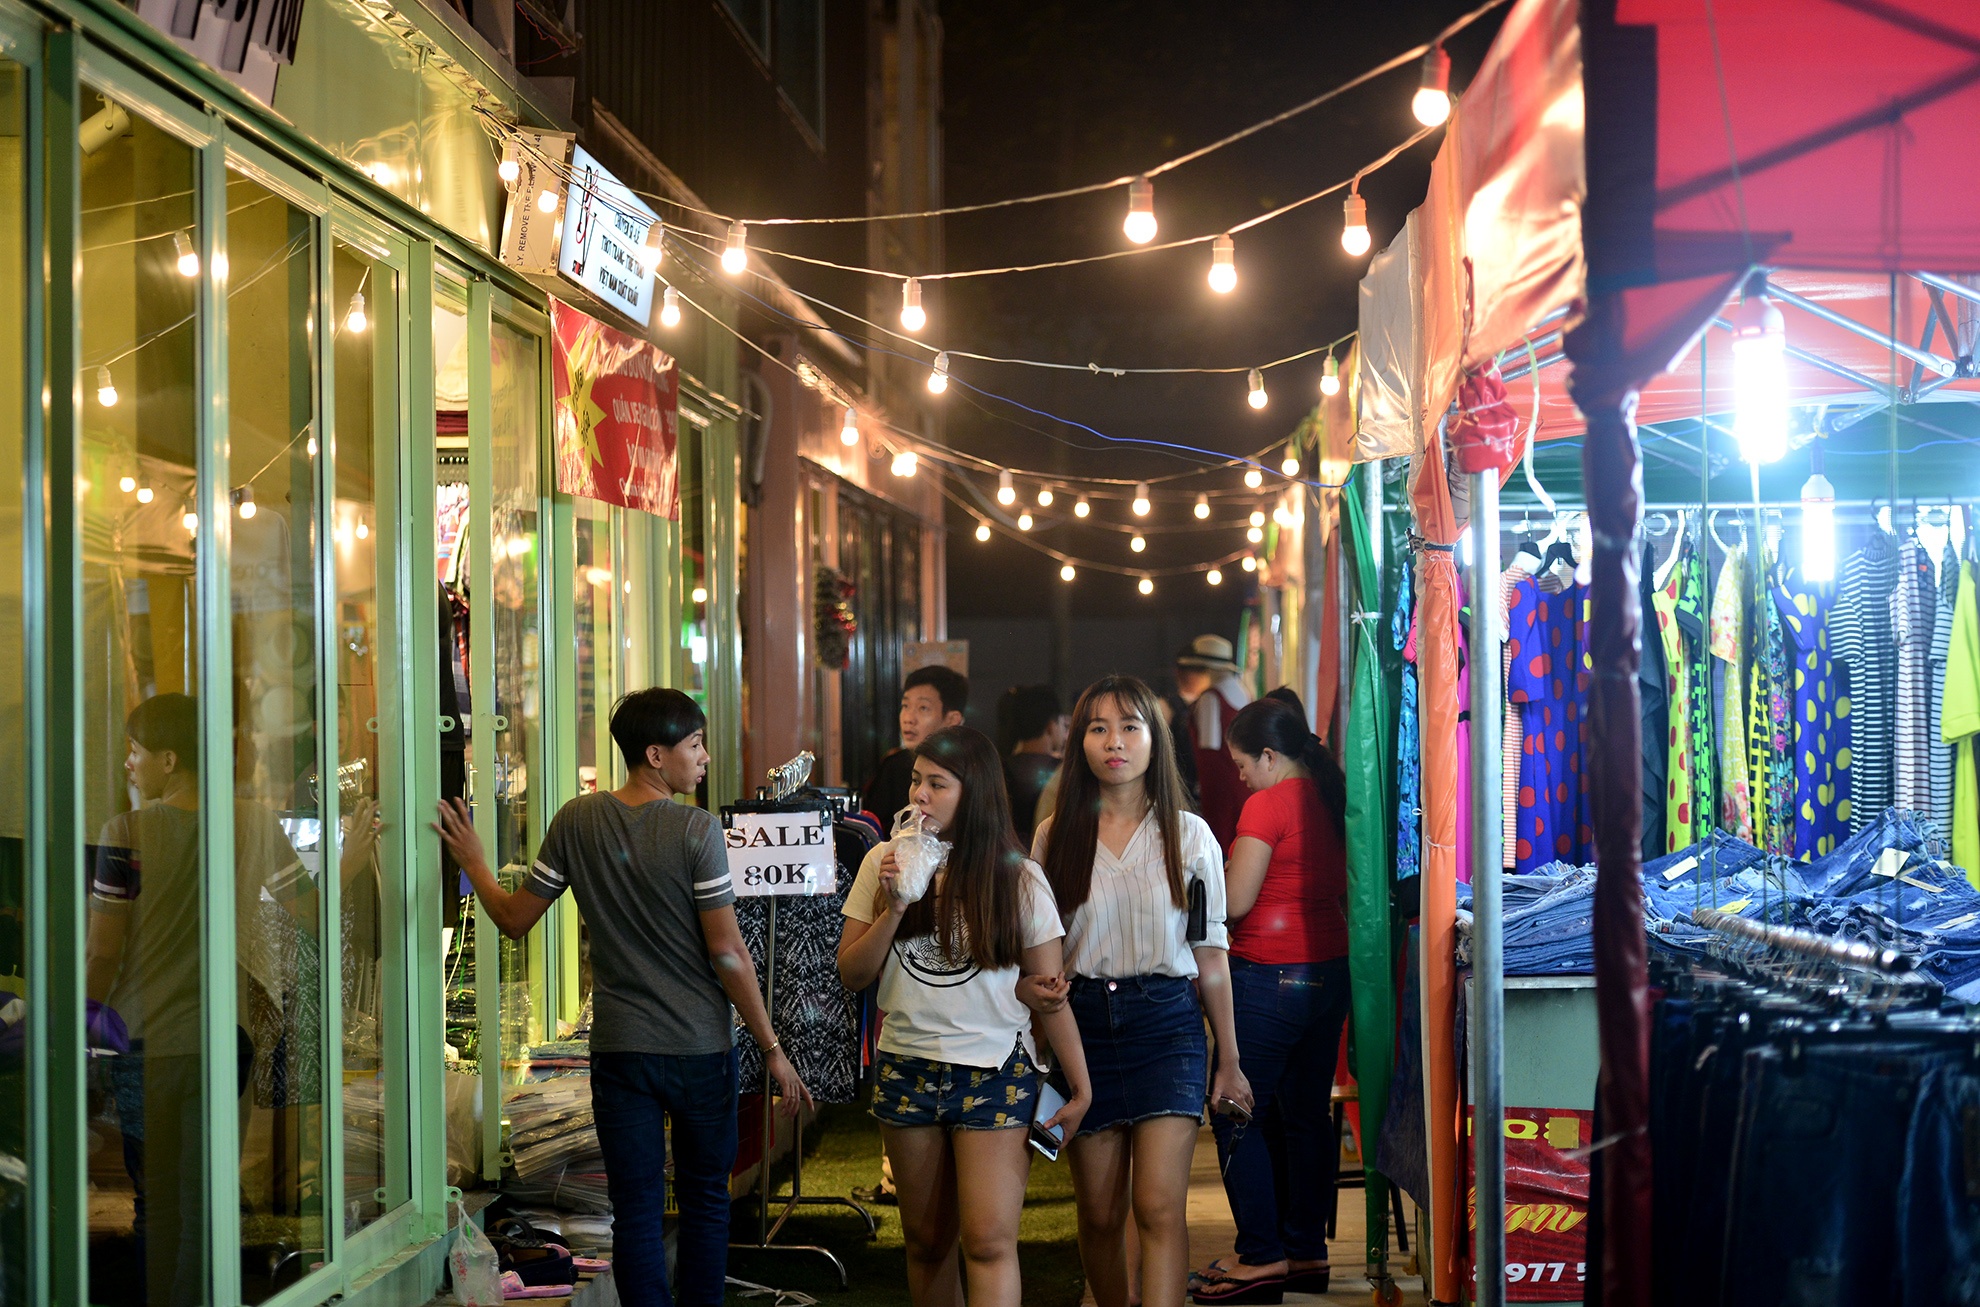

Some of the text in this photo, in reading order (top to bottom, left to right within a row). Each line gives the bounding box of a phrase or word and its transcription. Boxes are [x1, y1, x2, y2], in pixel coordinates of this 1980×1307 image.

[518, 215, 530, 251] REMOVE
[727, 825, 825, 848] SALE
[744, 862, 811, 886] 80K
[1504, 1262, 1566, 1283] 977
